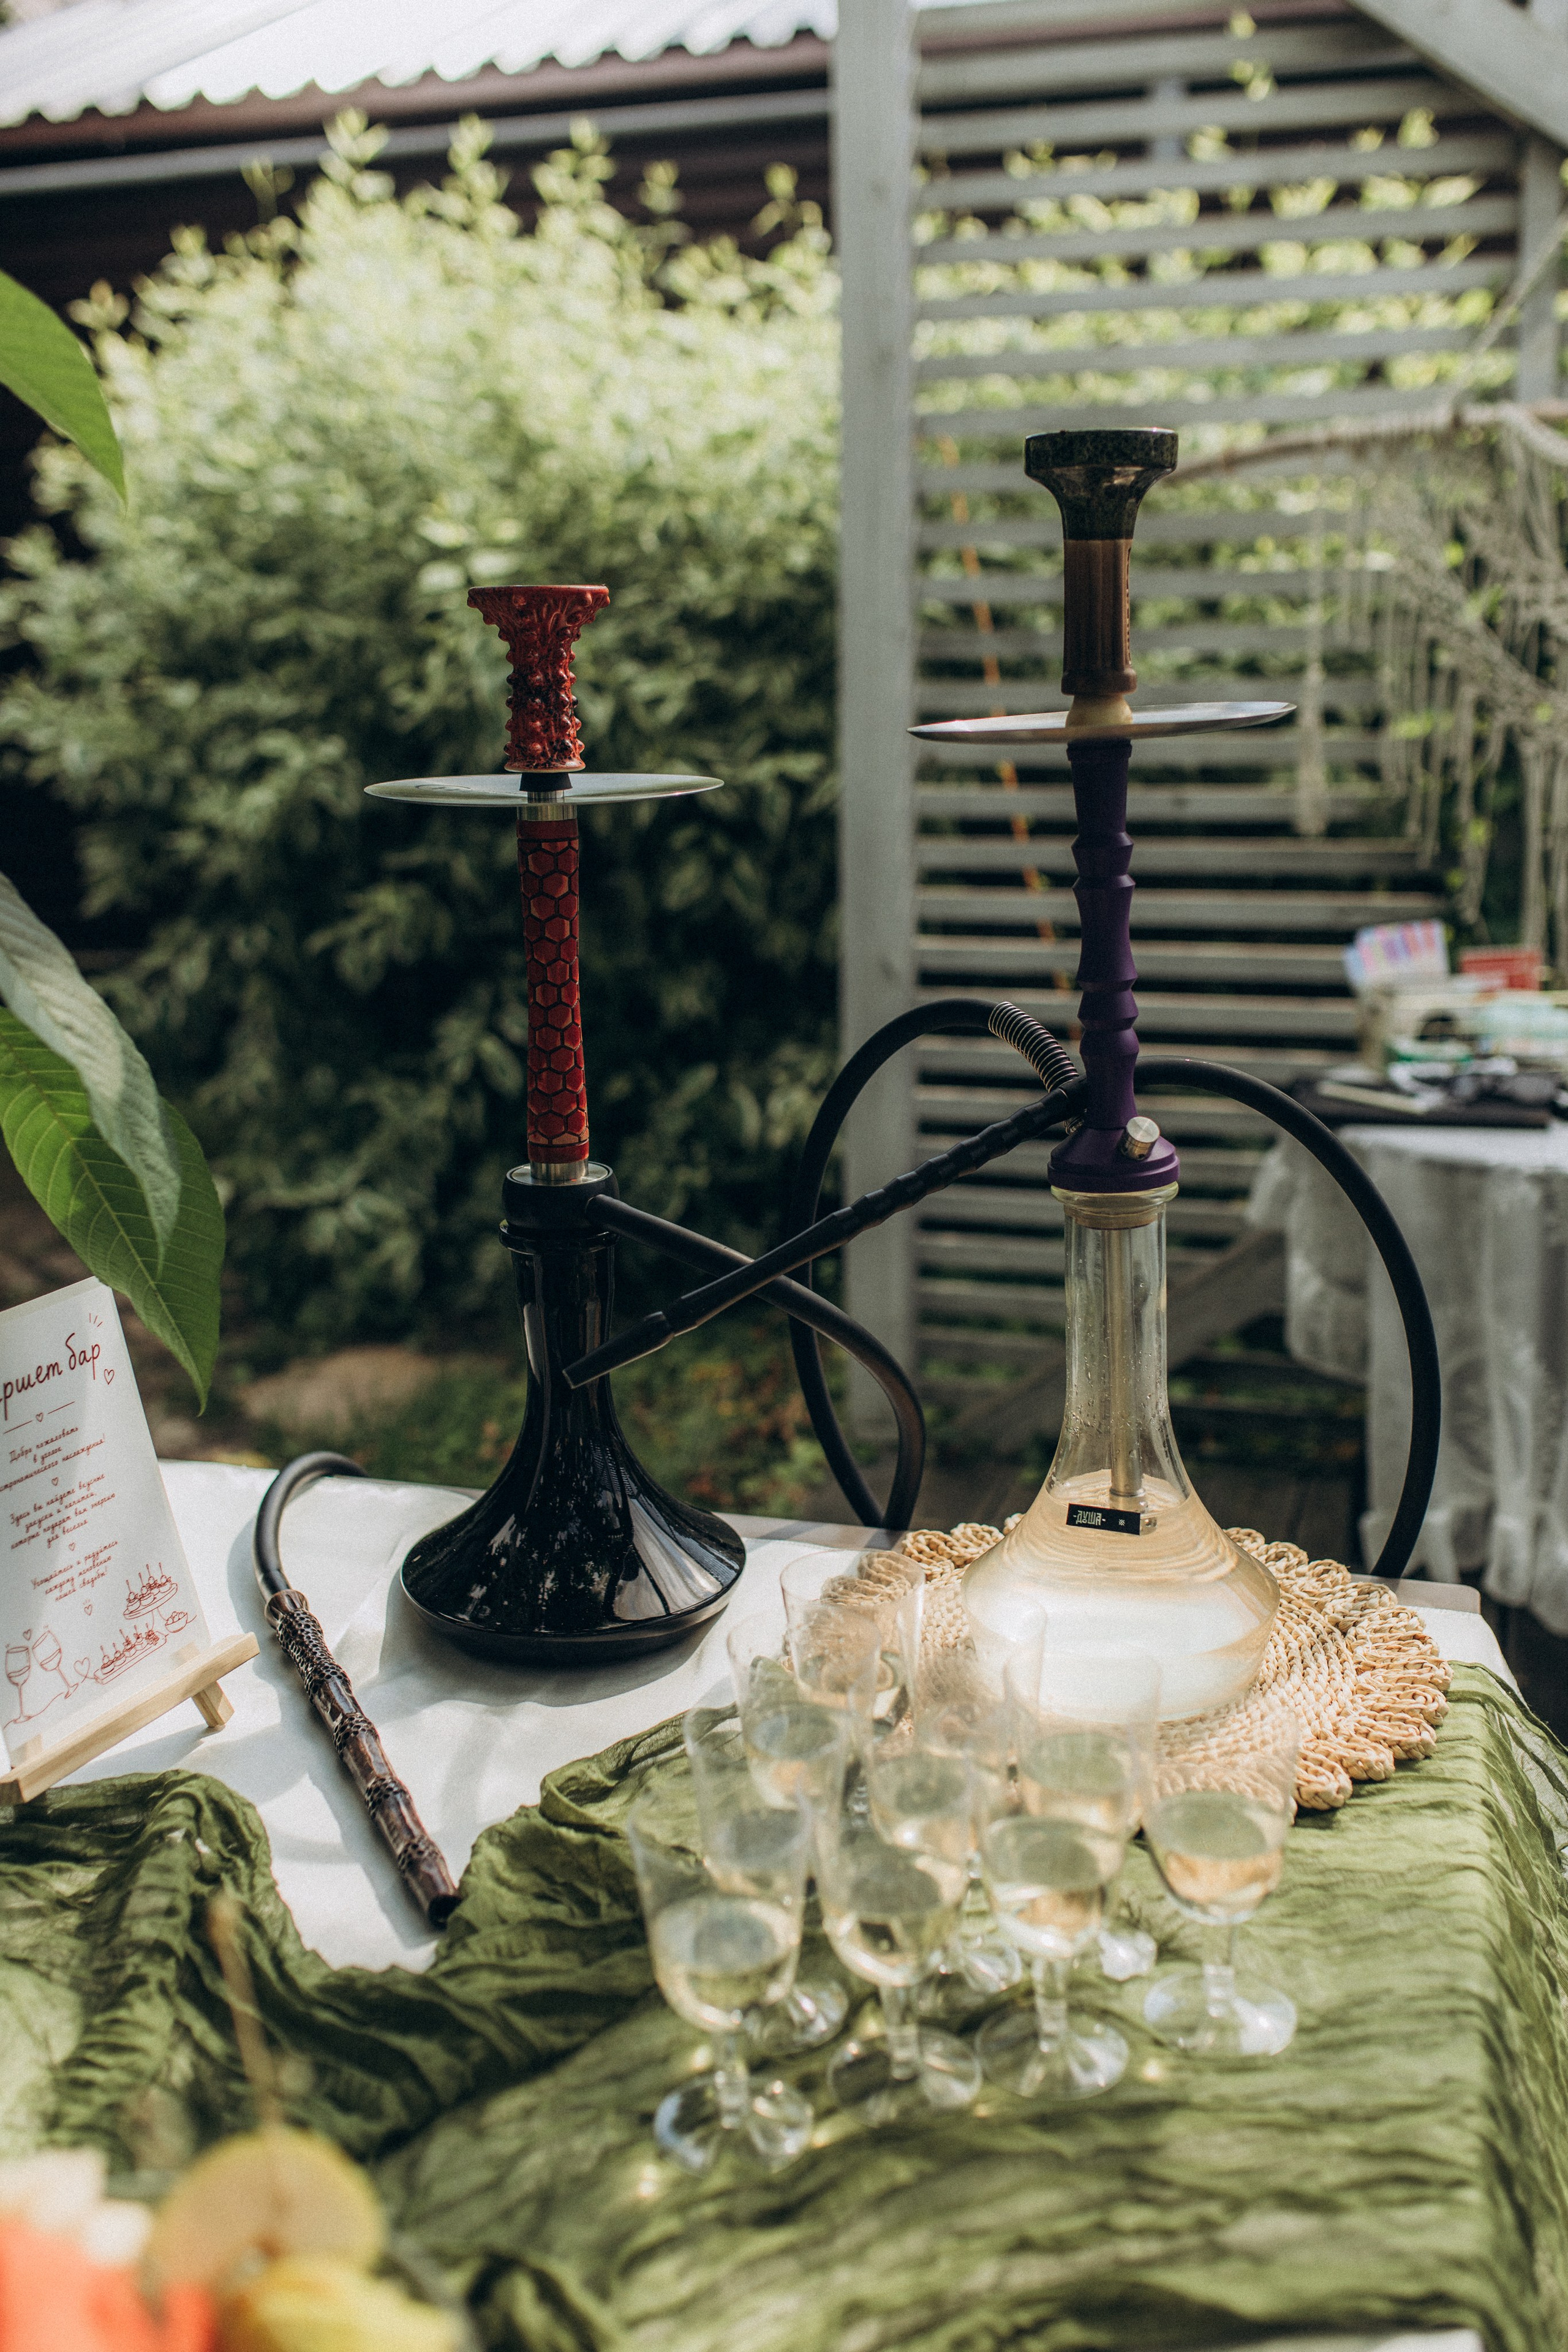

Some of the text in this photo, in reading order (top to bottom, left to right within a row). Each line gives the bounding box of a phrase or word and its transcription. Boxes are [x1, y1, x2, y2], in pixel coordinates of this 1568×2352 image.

[0, 1332, 100, 1421] ршет бар
[33, 1454, 37, 1463] в
